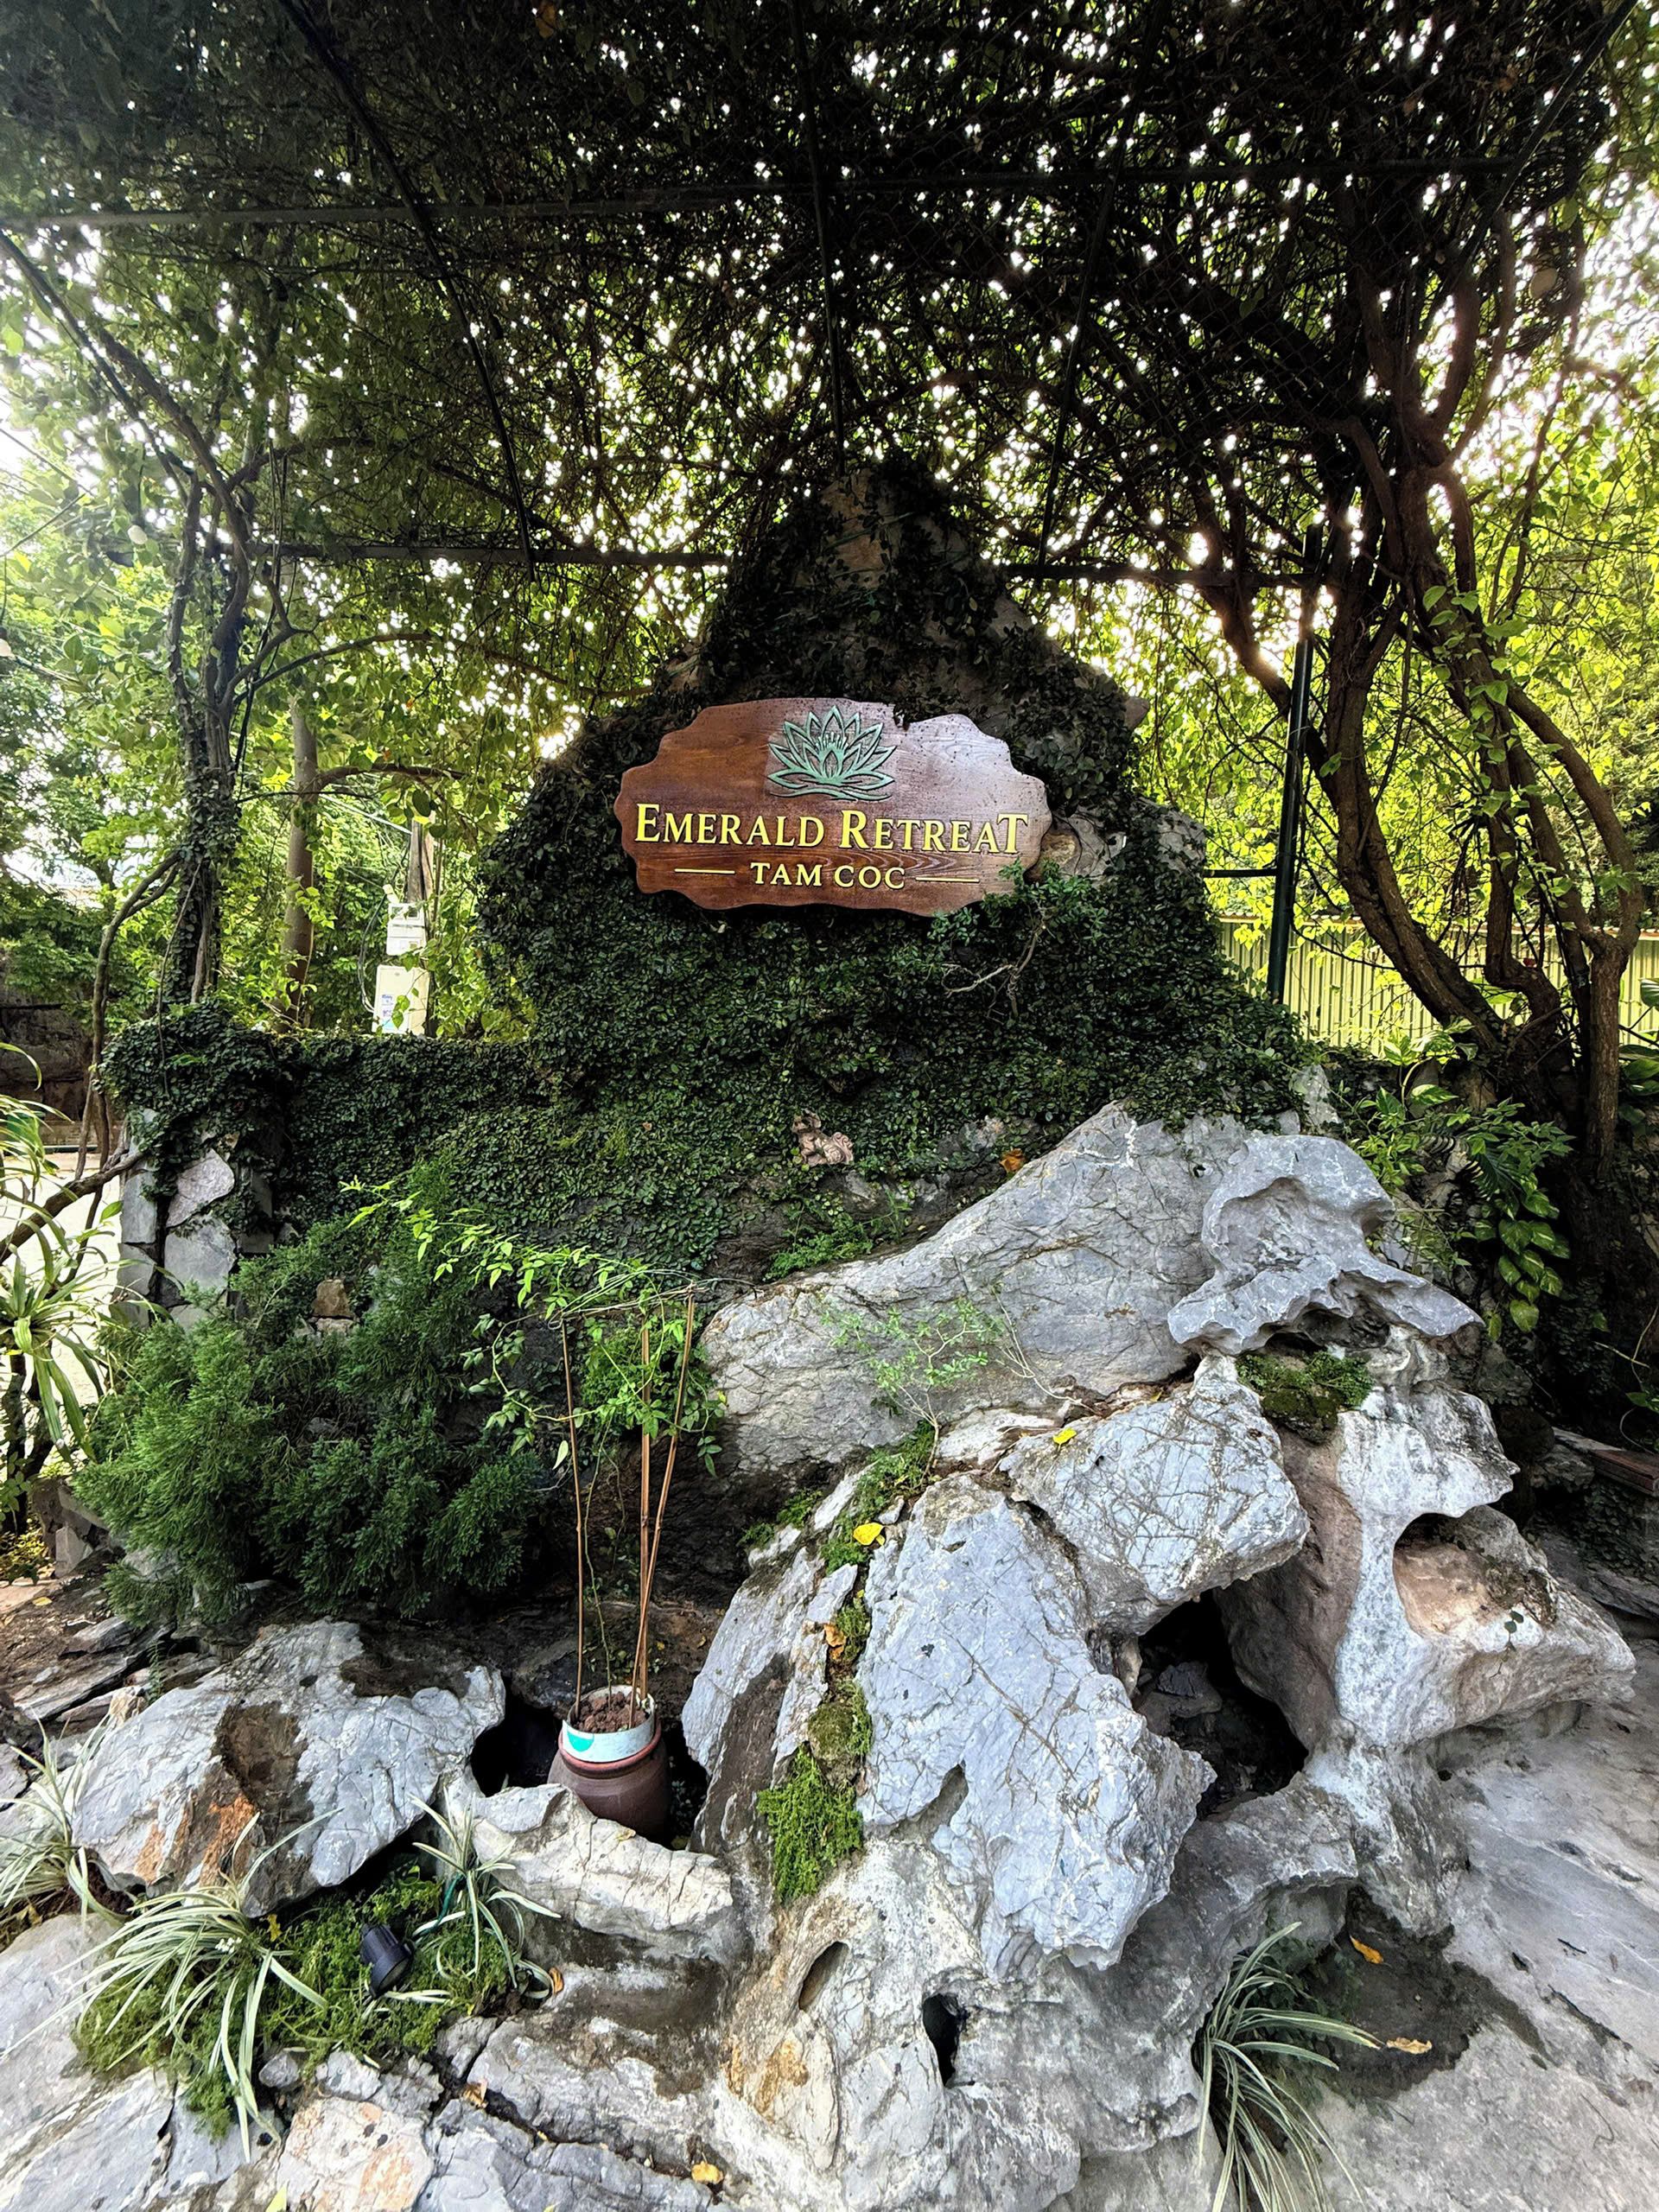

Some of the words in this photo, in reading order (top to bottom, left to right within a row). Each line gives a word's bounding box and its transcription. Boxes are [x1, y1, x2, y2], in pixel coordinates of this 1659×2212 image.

[635, 803, 825, 848] EMERALD
[838, 810, 1029, 855] RETREAT
[750, 861, 823, 887] TAM
[834, 865, 906, 890] COC
